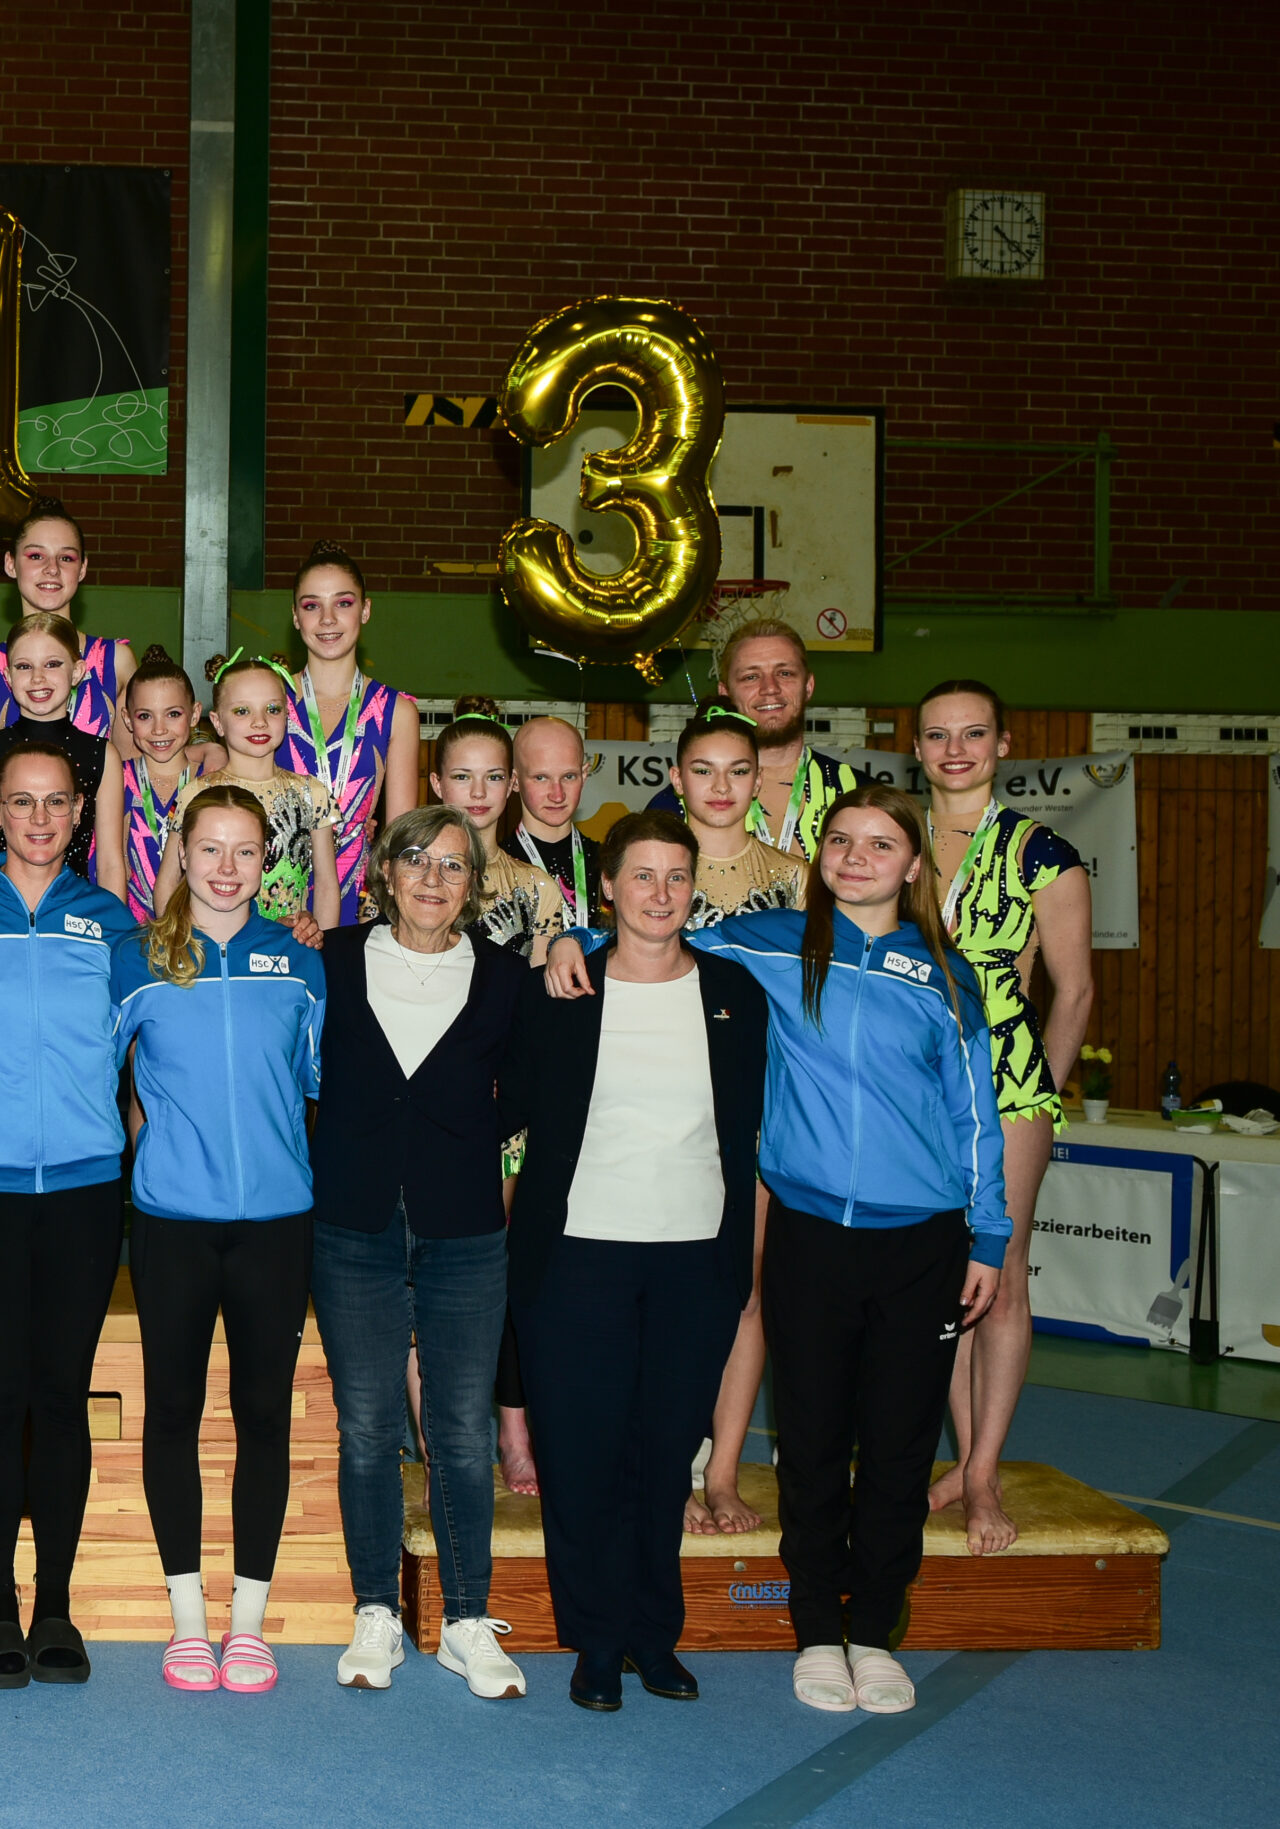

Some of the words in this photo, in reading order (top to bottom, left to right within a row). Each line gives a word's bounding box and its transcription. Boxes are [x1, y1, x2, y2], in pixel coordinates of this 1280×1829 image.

[1005, 766, 1071, 797] e.V.
[251, 959, 269, 968] HSC
[886, 956, 908, 969] HSC
